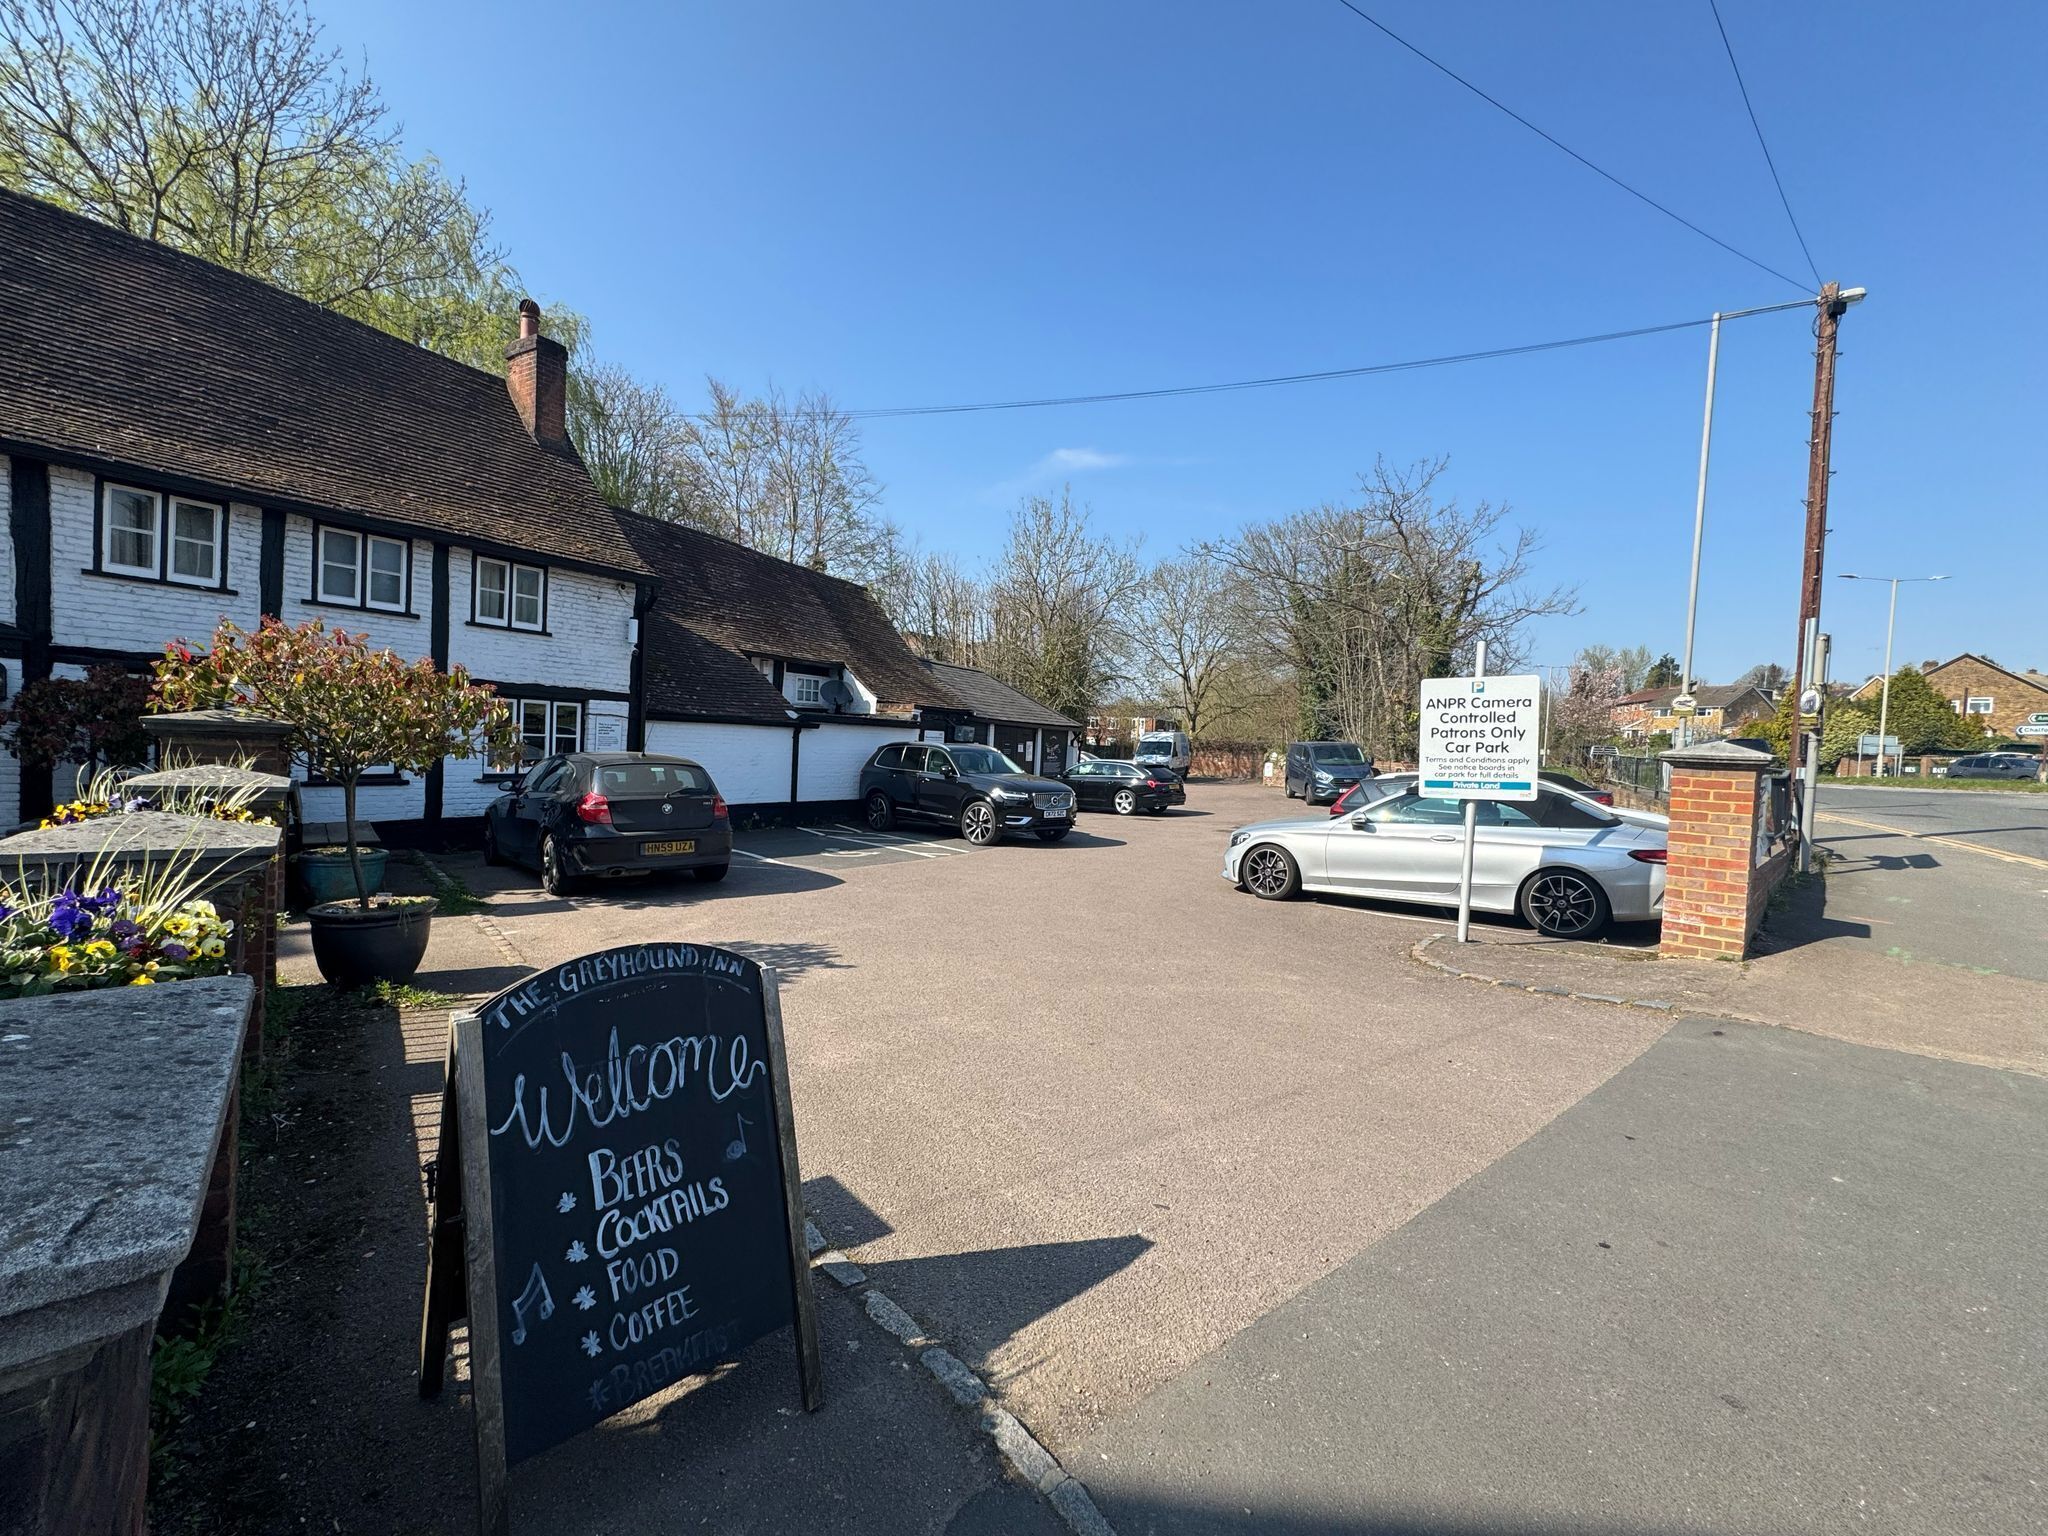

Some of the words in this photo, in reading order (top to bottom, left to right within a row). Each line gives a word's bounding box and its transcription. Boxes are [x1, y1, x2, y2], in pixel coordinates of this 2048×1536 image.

[1426, 698, 1466, 709] ANPR
[1471, 697, 1532, 708] Camera
[1440, 711, 1516, 723] Controlled
[1431, 727, 1486, 739] Patrons
[1491, 726, 1526, 741] Only
[1445, 742, 1470, 753] Car
[1476, 741, 1510, 753] Park
[1480, 782, 1500, 790] Land
[647, 843, 673, 853] HN59
[675, 842, 694, 852] UZA
[486, 981, 549, 1029] THE
[559, 944, 699, 993] GREYHOUND
[708, 950, 746, 977] INN
[490, 1026, 767, 1149] Welcome
[588, 1138, 684, 1211] BEERS
[596, 1176, 730, 1260] COCKTAILS
[606, 1248, 680, 1302] FOOD
[609, 1284, 700, 1350] COFFEE
